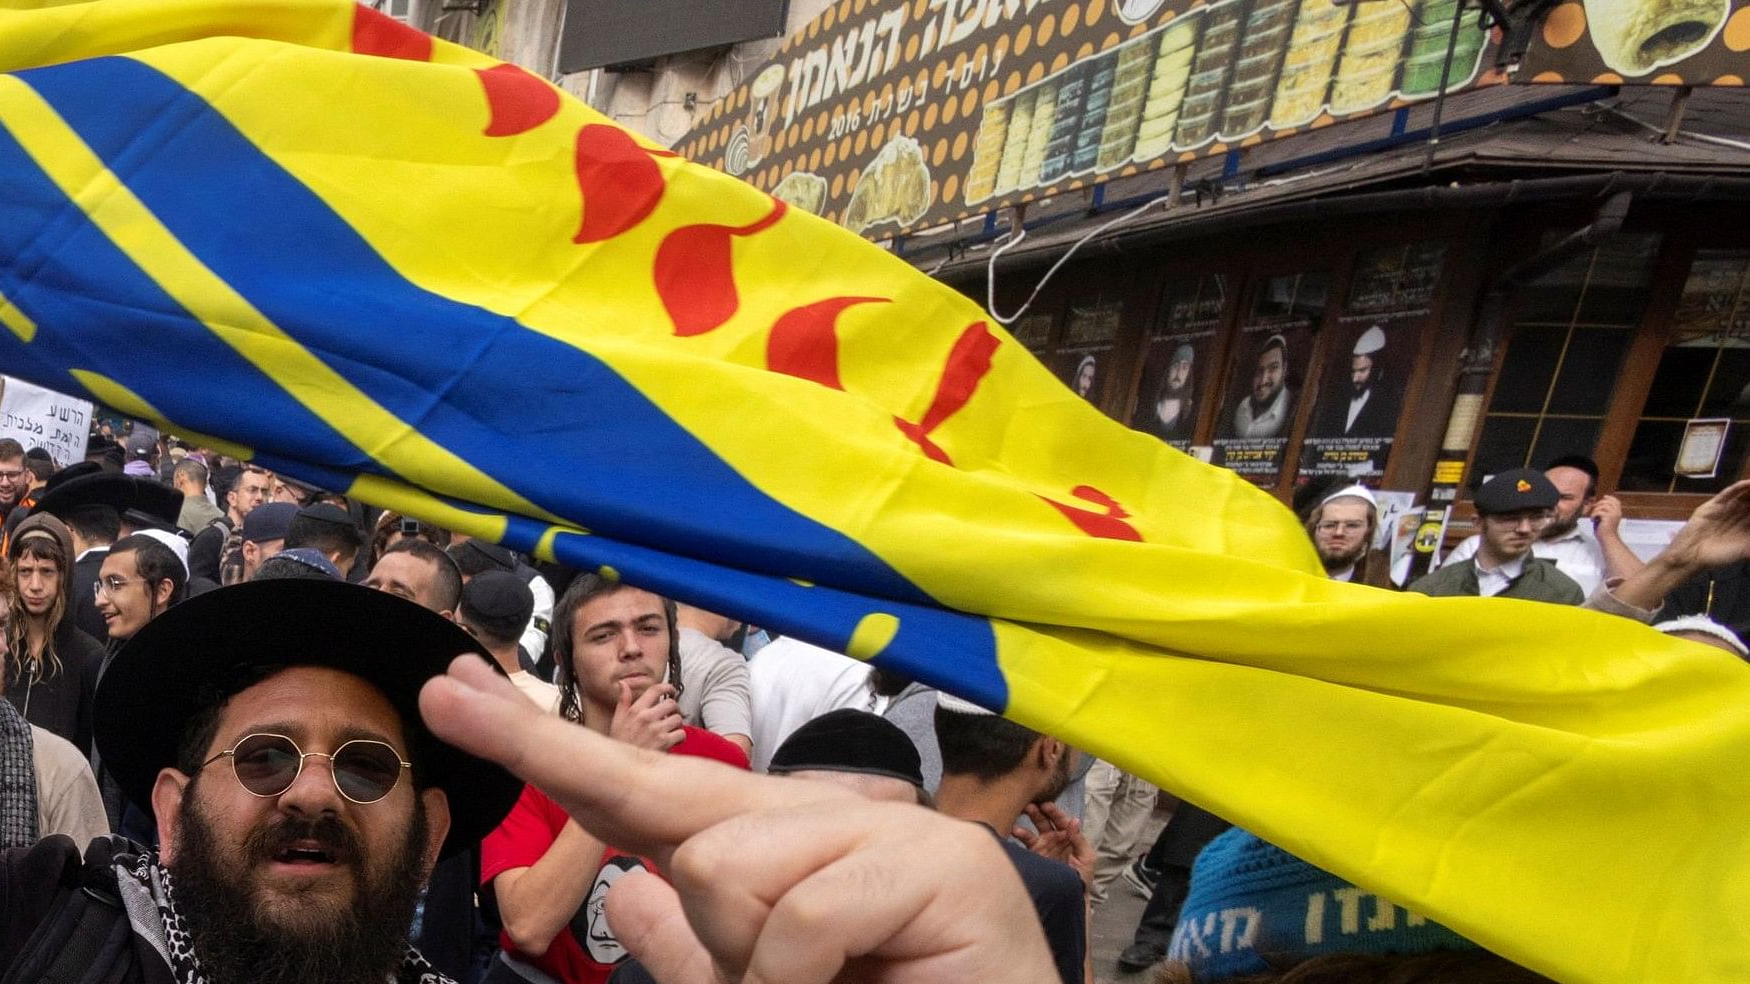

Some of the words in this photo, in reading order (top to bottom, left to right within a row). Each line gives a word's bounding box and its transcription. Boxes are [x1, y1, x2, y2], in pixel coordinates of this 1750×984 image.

[783, 6, 905, 131] הנאמן
[945, 49, 1002, 94] נוסד
[827, 108, 861, 141] 2016
[866, 79, 929, 126] בשנת
[45, 405, 84, 427] הרשע
